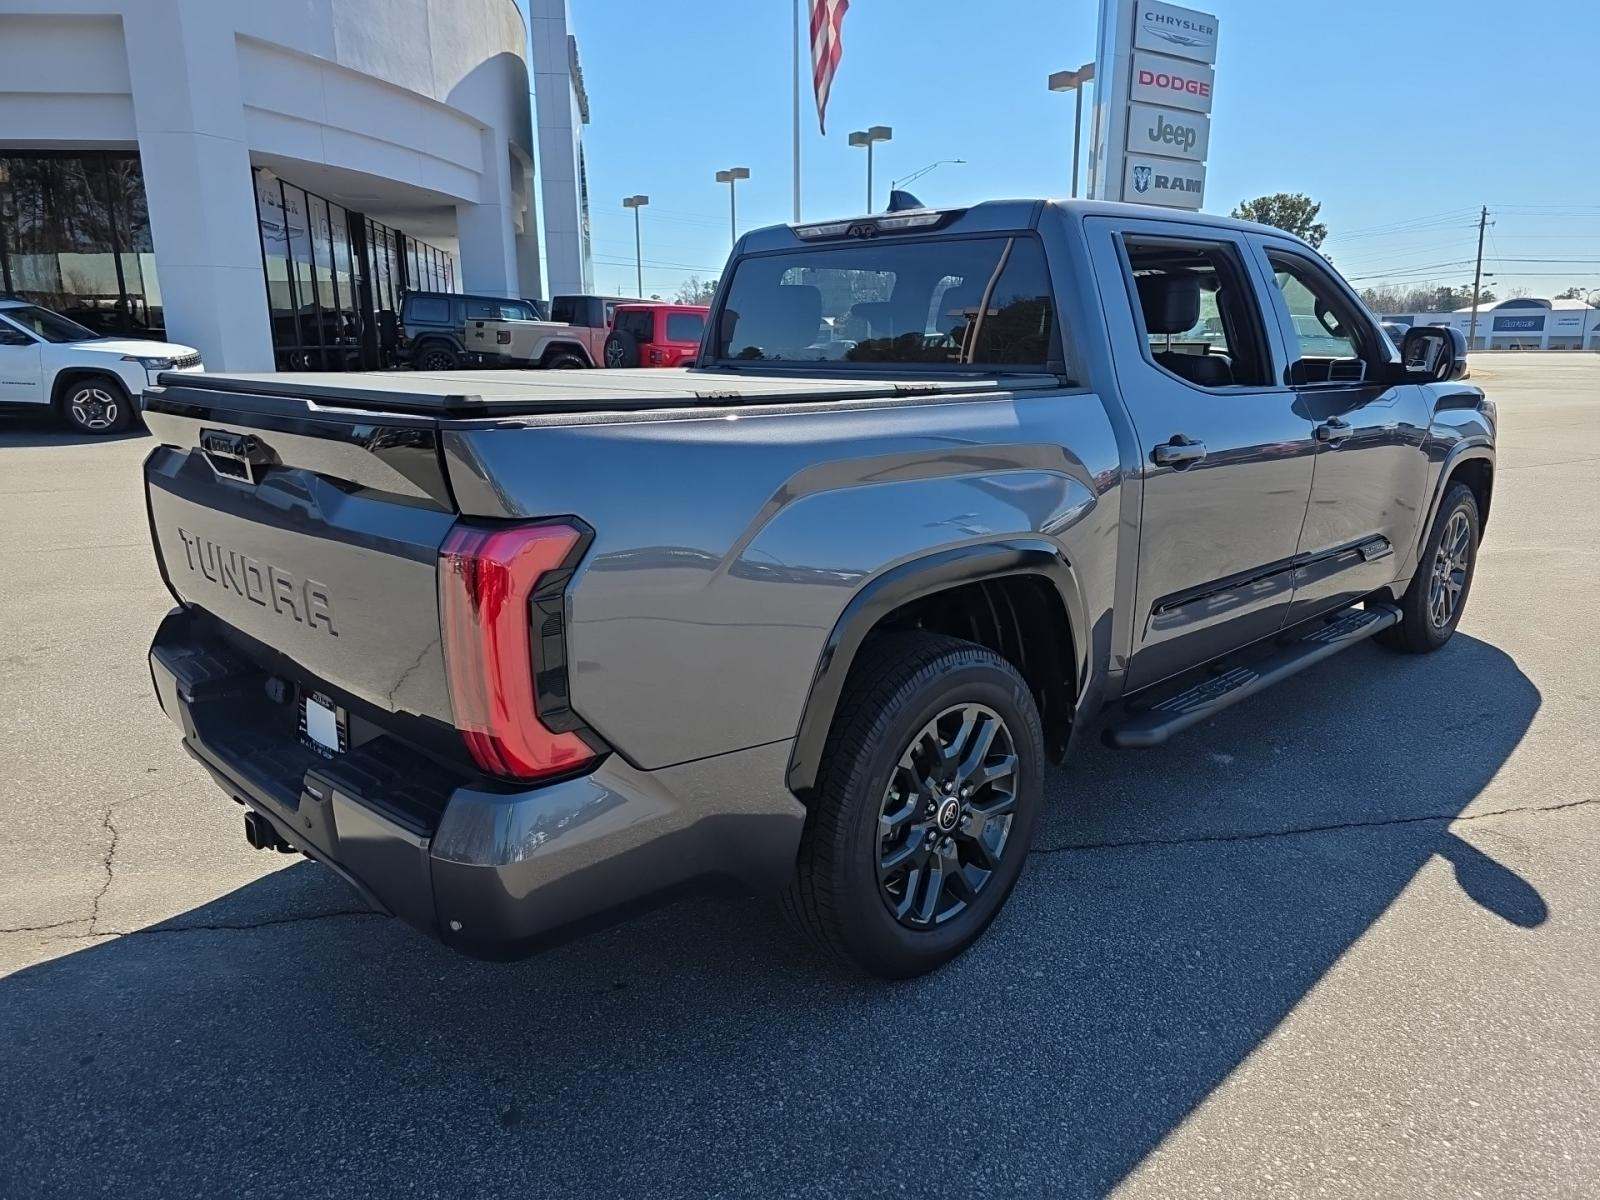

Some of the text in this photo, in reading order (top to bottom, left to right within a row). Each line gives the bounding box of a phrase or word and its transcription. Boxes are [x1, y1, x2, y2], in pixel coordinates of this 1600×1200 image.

[1144, 12, 1214, 36] CHRYSLER
[1138, 70, 1211, 97] DODGE
[1148, 114, 1197, 153] Jeep
[1154, 174, 1202, 193] RAM
[177, 527, 339, 637] TUNDRA
